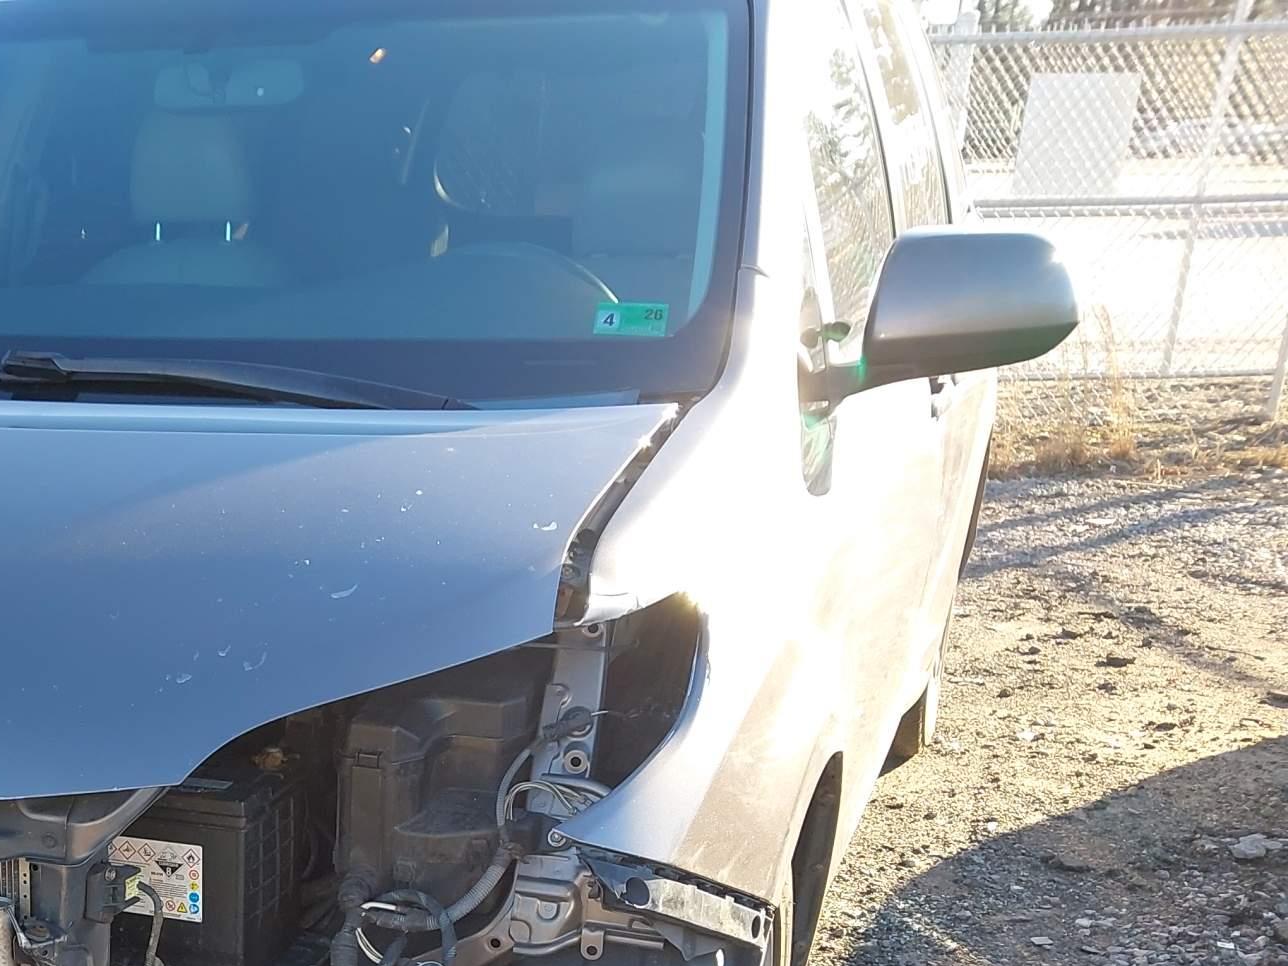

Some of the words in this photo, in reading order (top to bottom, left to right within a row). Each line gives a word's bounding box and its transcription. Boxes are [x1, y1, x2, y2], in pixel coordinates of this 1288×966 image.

[603, 313, 615, 326] 4
[644, 309, 663, 321] 26
[166, 867, 172, 876] 8
